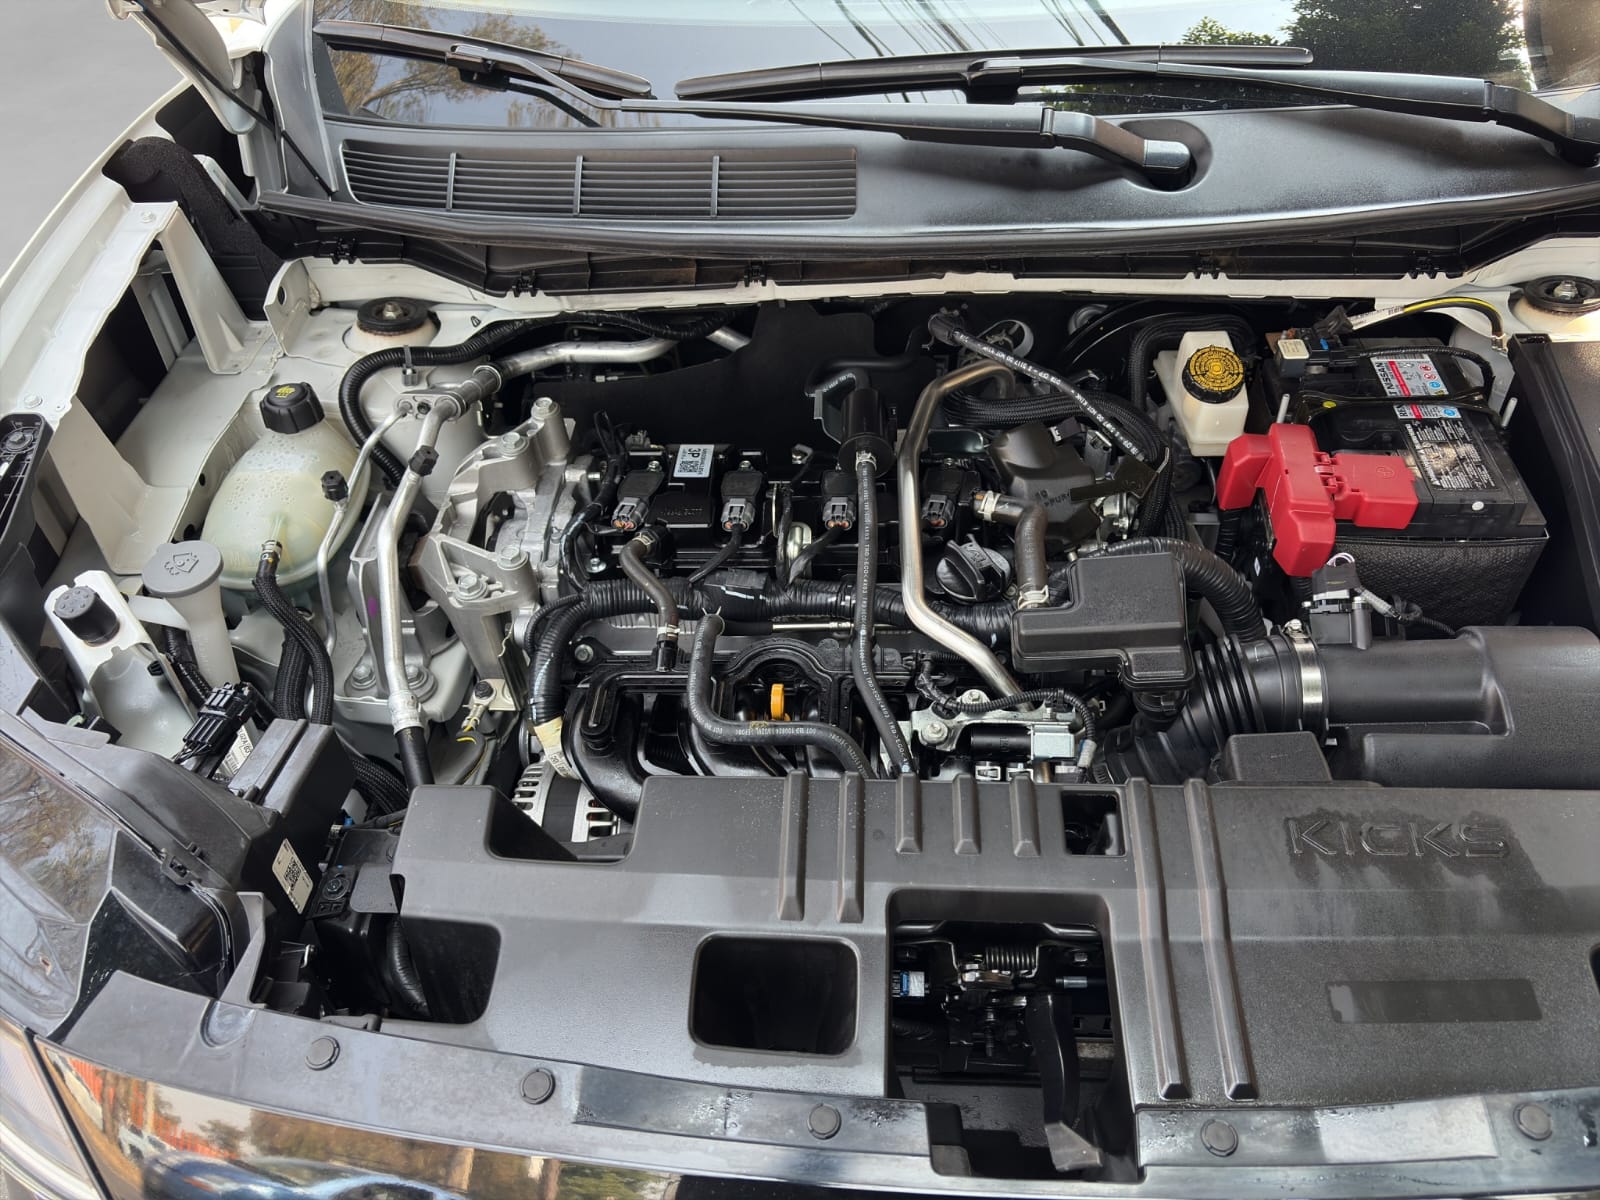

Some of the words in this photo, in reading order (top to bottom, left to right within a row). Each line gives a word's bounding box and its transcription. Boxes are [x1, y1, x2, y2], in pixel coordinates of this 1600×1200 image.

[1375, 362, 1395, 390] NISSAN
[688, 448, 701, 458] 3P
[1287, 820, 1509, 857] KICKS
